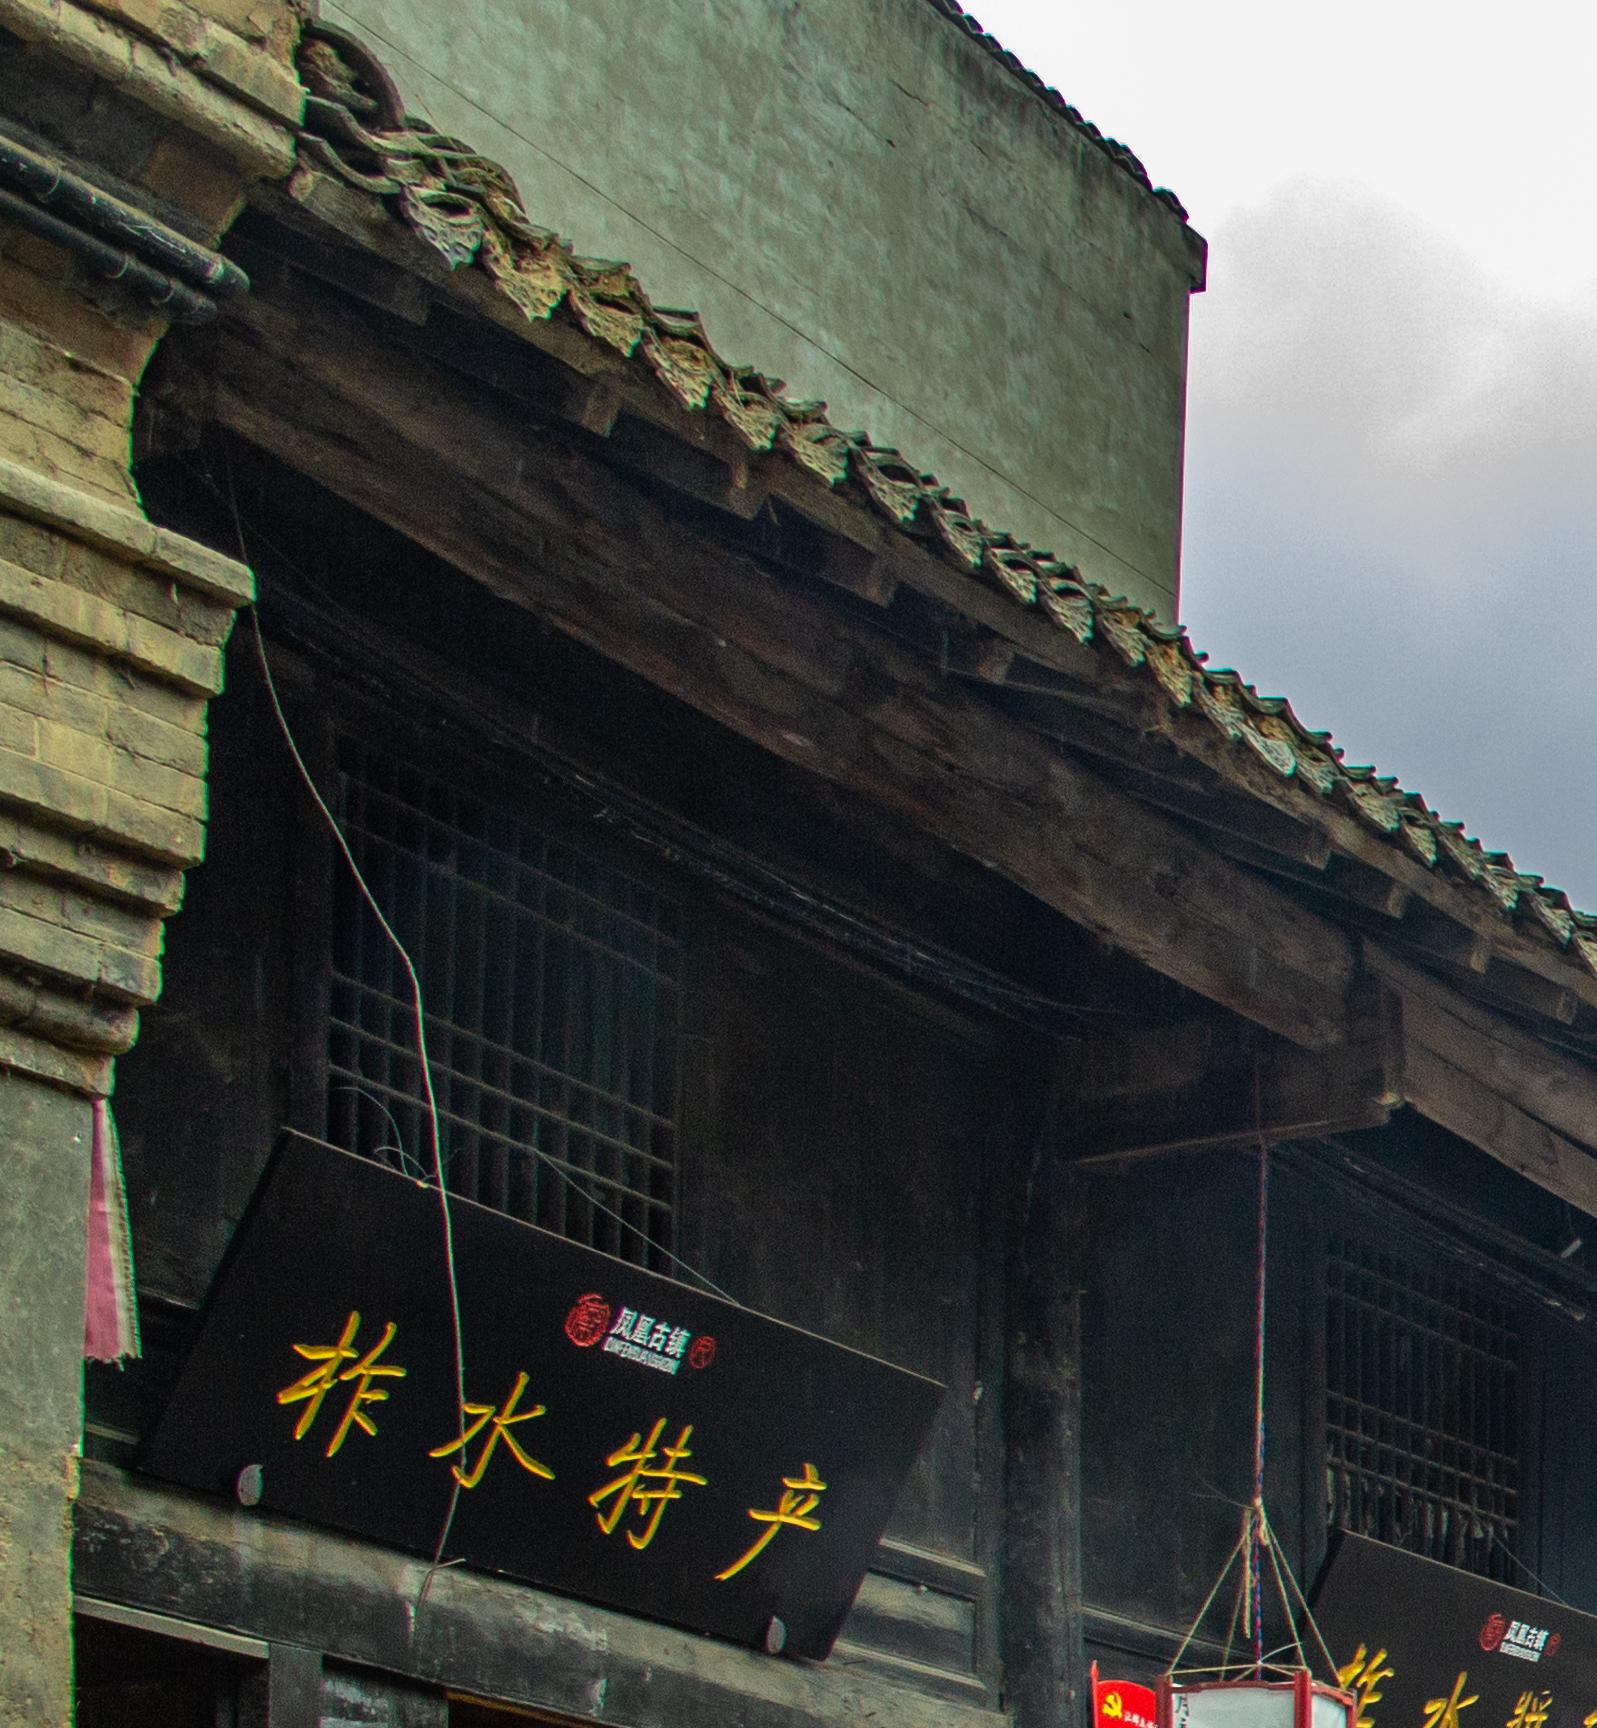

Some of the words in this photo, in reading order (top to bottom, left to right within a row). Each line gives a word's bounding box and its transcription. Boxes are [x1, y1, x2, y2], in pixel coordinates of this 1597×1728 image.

[609, 1305, 692, 1359] 凤凰古镇
[277, 1309, 828, 1582] 柞水特产
